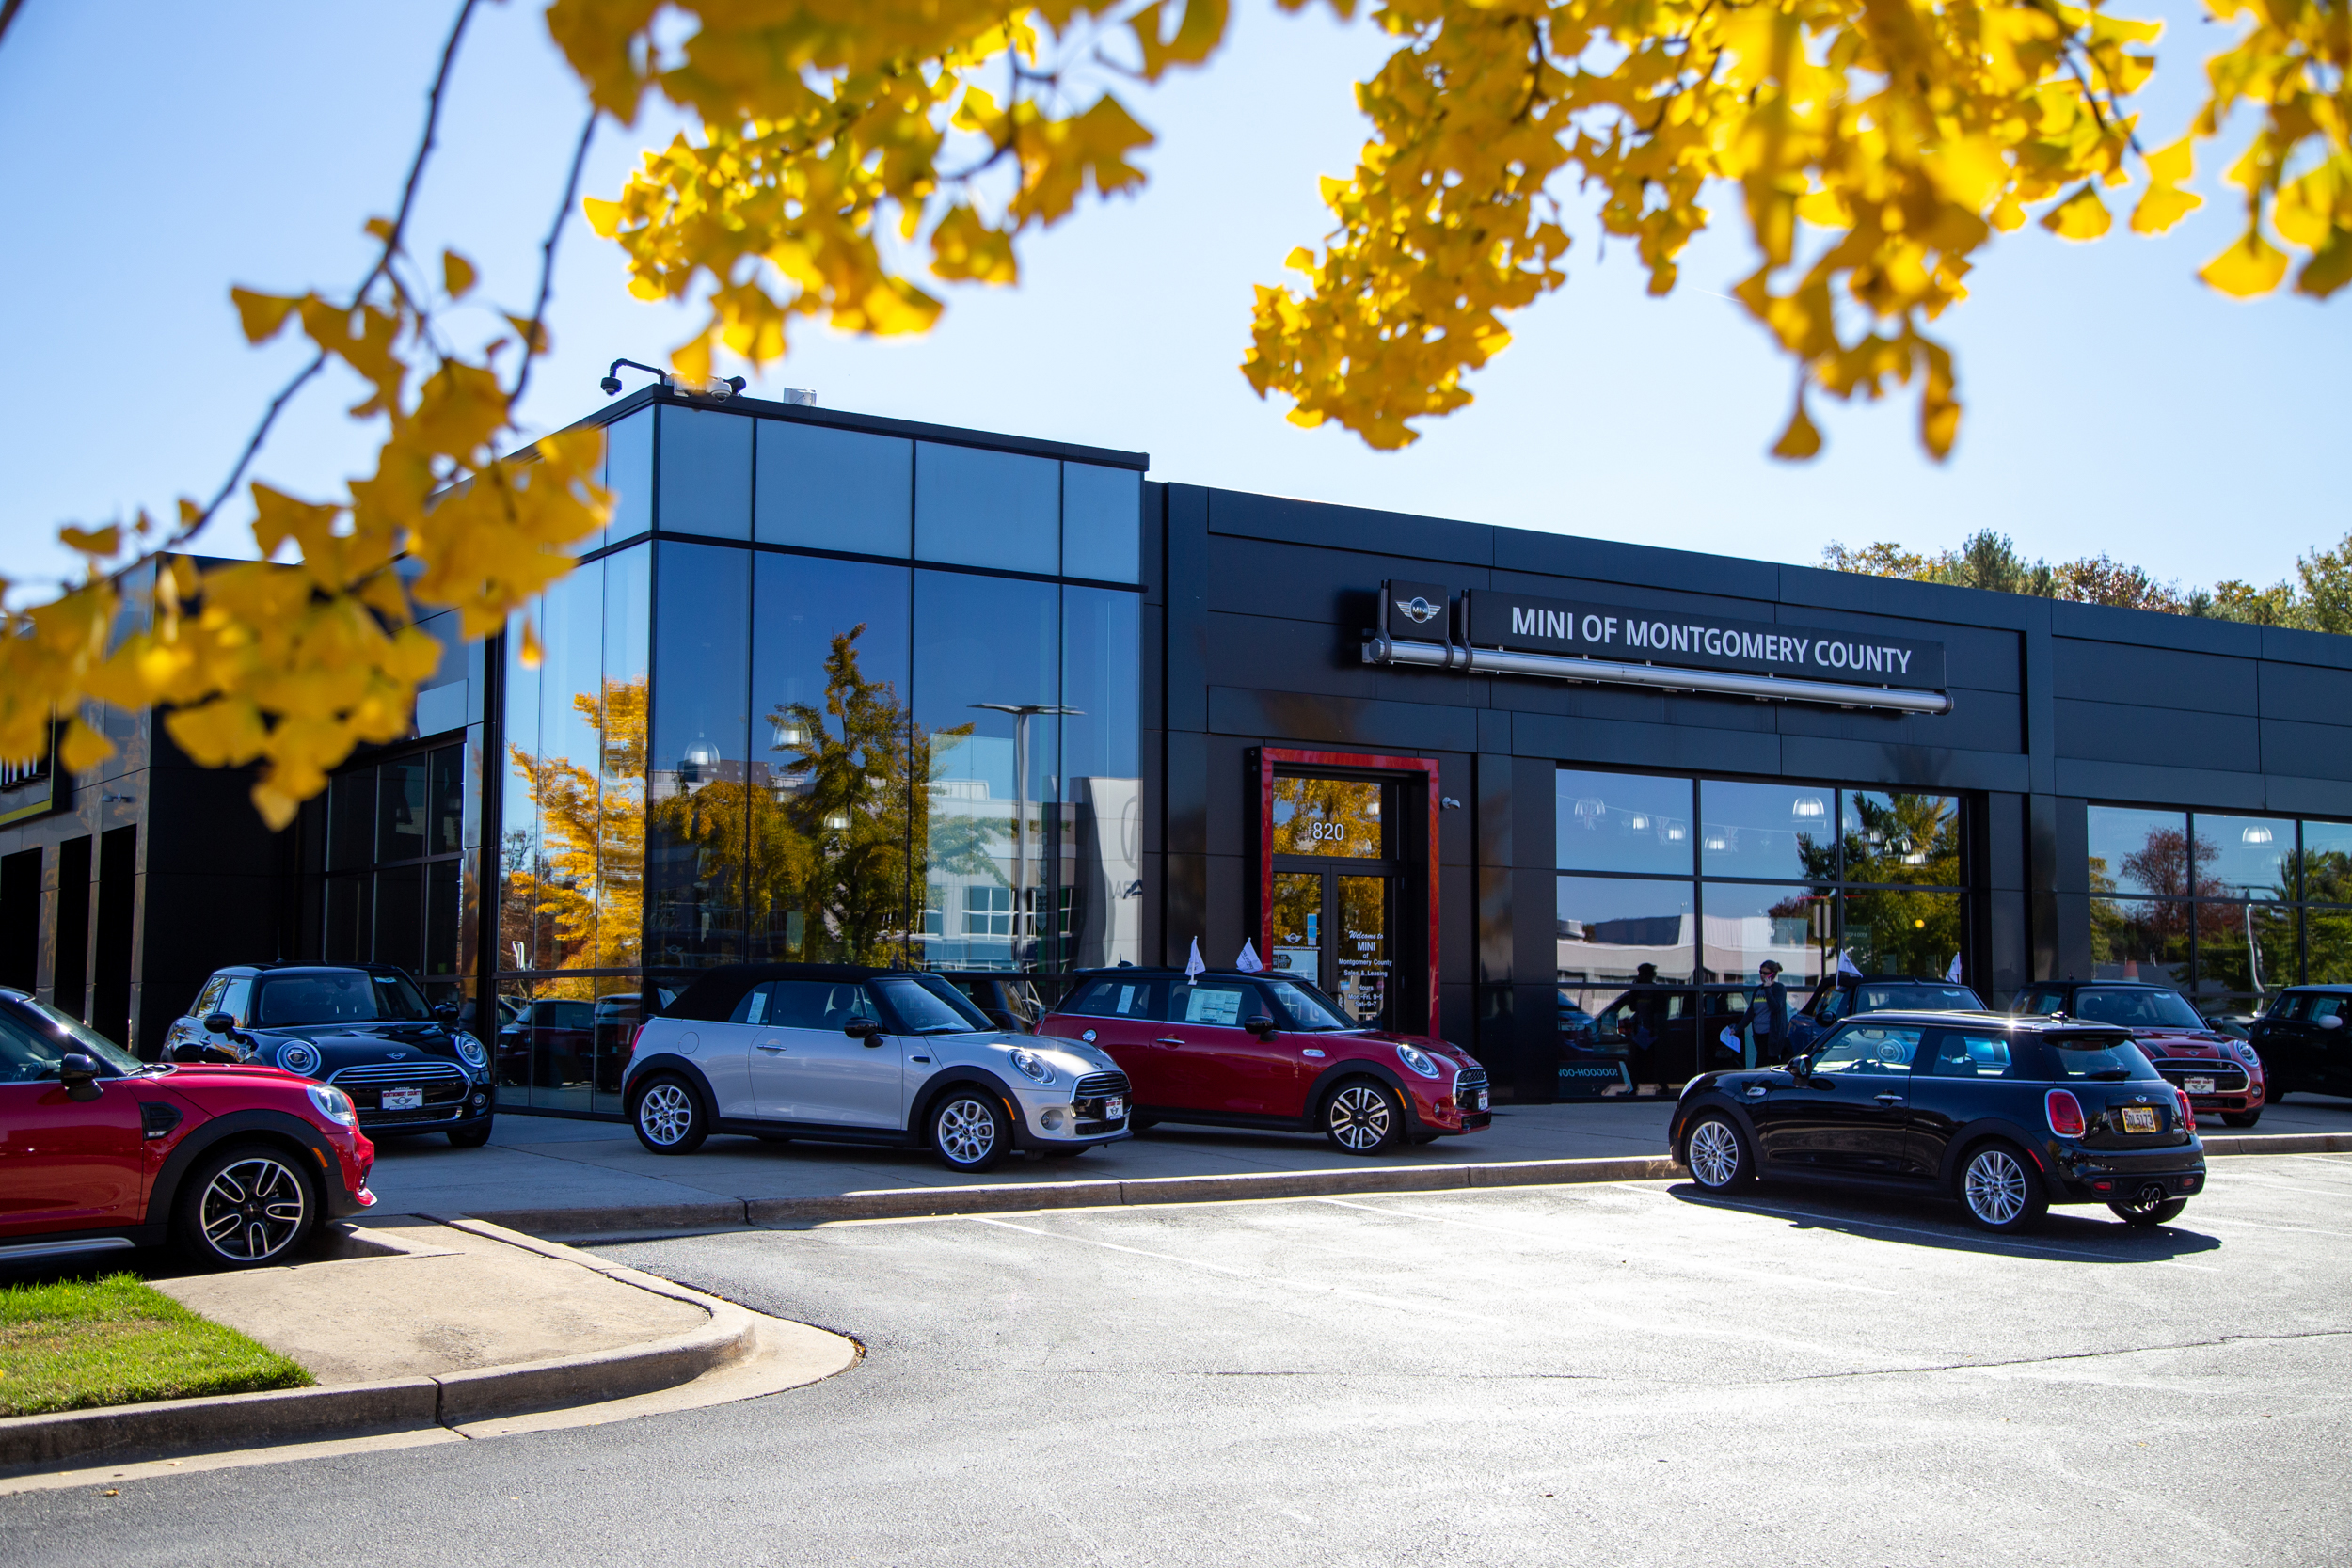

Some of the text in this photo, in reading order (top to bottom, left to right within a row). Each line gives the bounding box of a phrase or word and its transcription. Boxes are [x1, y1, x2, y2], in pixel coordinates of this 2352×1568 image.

[1512, 607, 1912, 674] MINI OF MONTGOMERY COUNTY
[1312, 821, 1344, 841] 820
[1348, 930, 1376, 940] Welcome
[1357, 942, 1375, 951] MINI
[1367, 970, 1389, 978] Leasing
